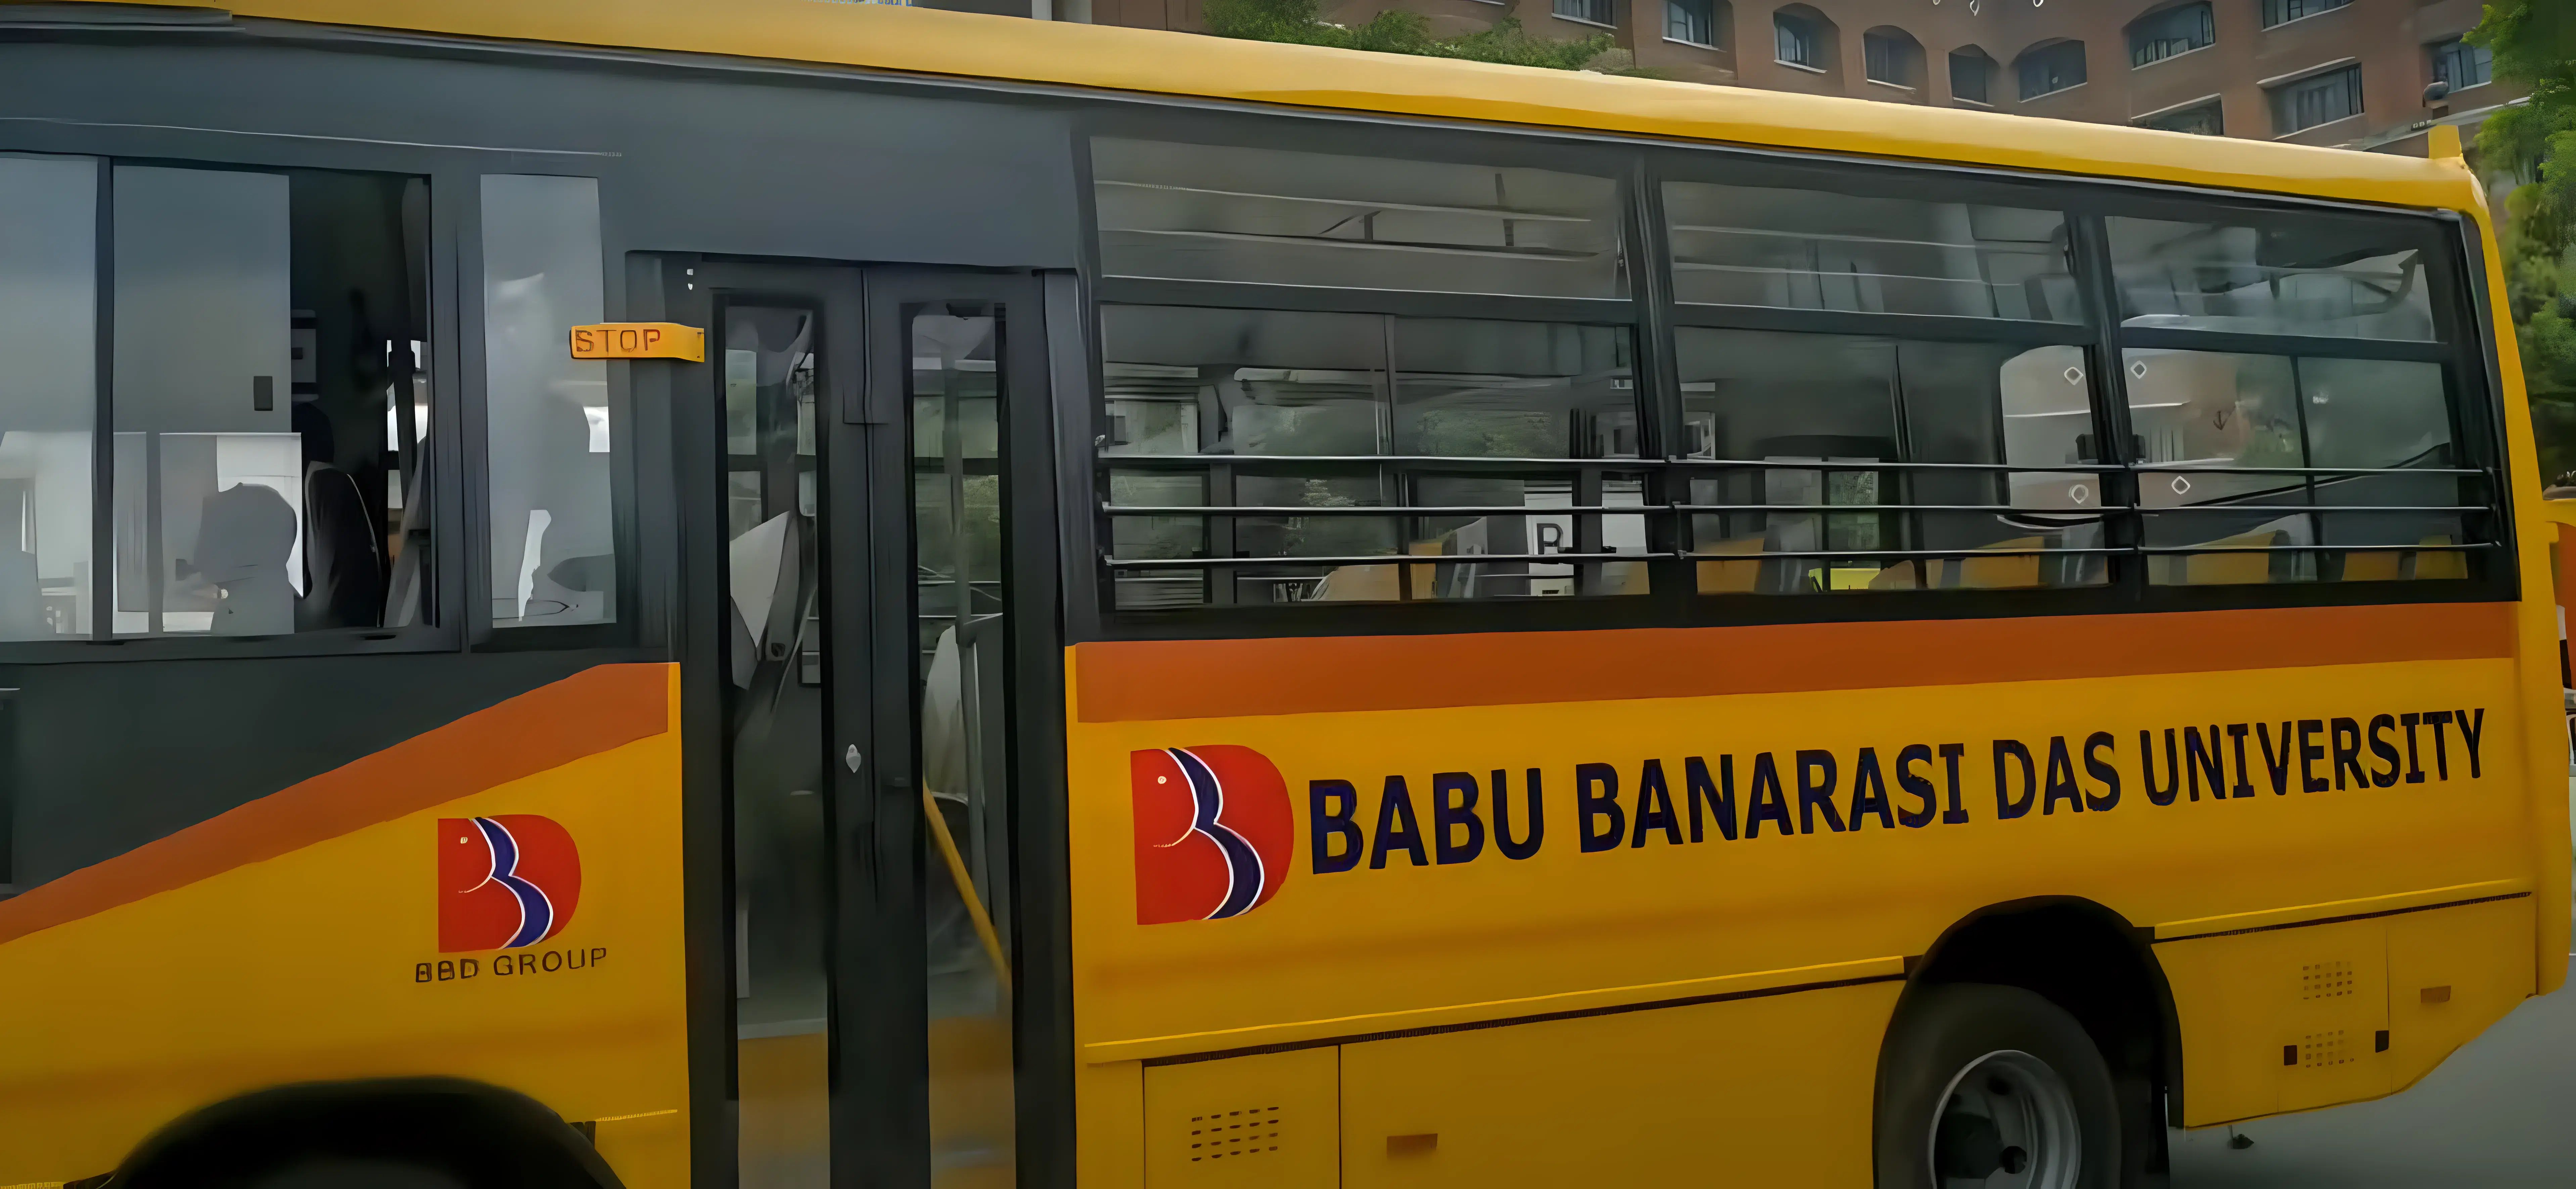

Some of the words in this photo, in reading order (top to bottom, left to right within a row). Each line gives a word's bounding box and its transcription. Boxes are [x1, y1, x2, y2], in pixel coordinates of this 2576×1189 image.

[576, 329, 660, 355] STOP
[1309, 768, 1544, 875] BABU
[1576, 743, 1969, 853] BANARASI
[1993, 732, 2121, 820] DAS
[2140, 708, 2485, 806] UNIVERSITY
[415, 959, 479, 983] BBD
[493, 947, 607, 976] GROUP
